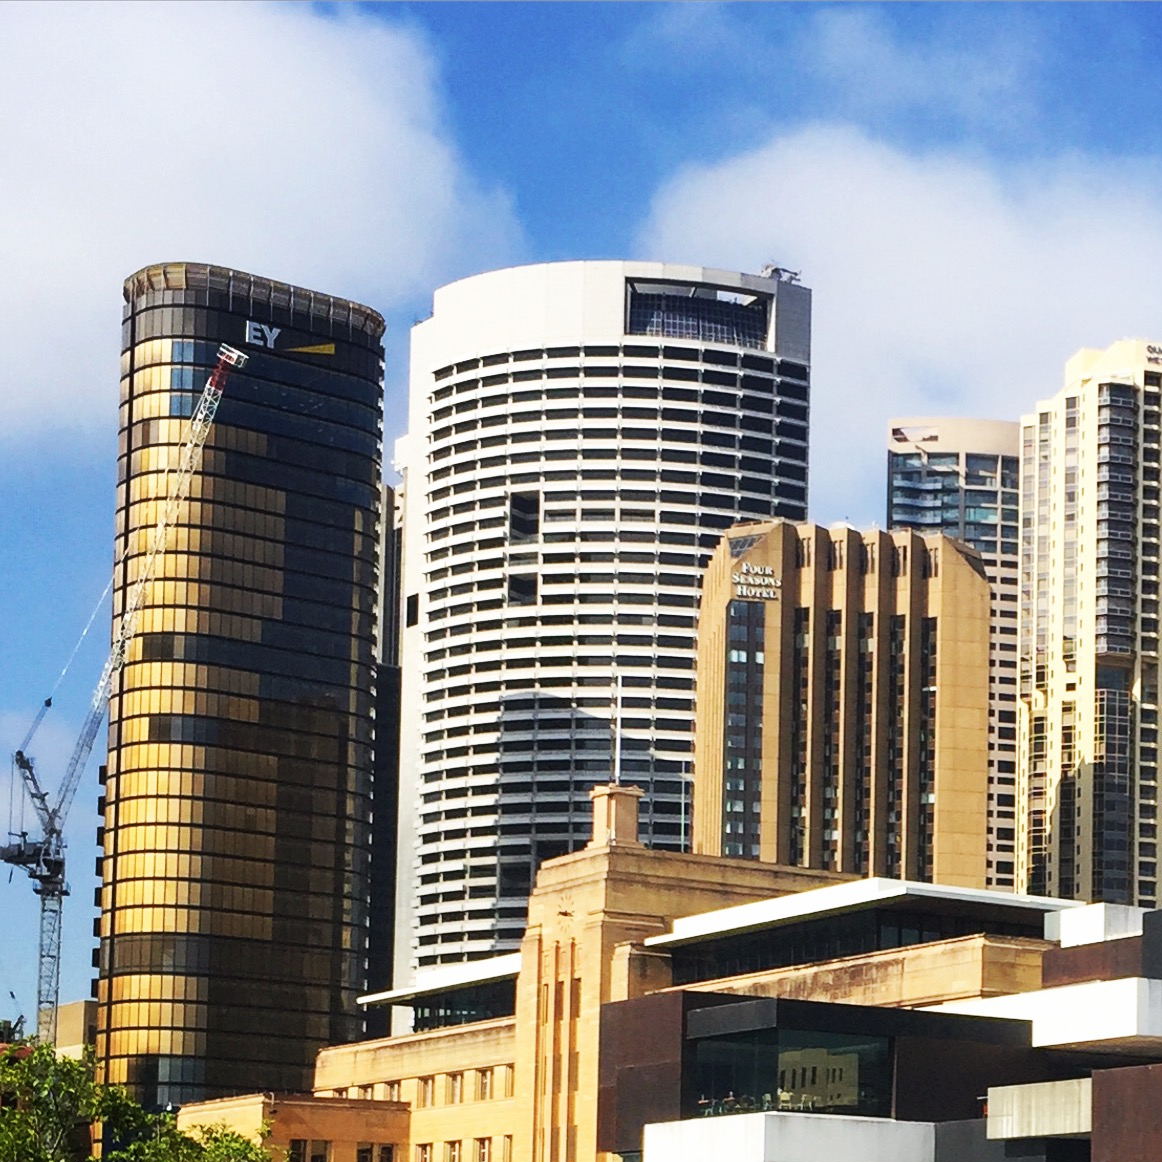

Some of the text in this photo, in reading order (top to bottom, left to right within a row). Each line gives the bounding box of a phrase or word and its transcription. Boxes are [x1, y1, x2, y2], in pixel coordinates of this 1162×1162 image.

[245, 320, 281, 349] EY
[741, 562, 774, 575] FOUR
[732, 572, 782, 588] SEASONS
[736, 585, 777, 599] HOTEL
